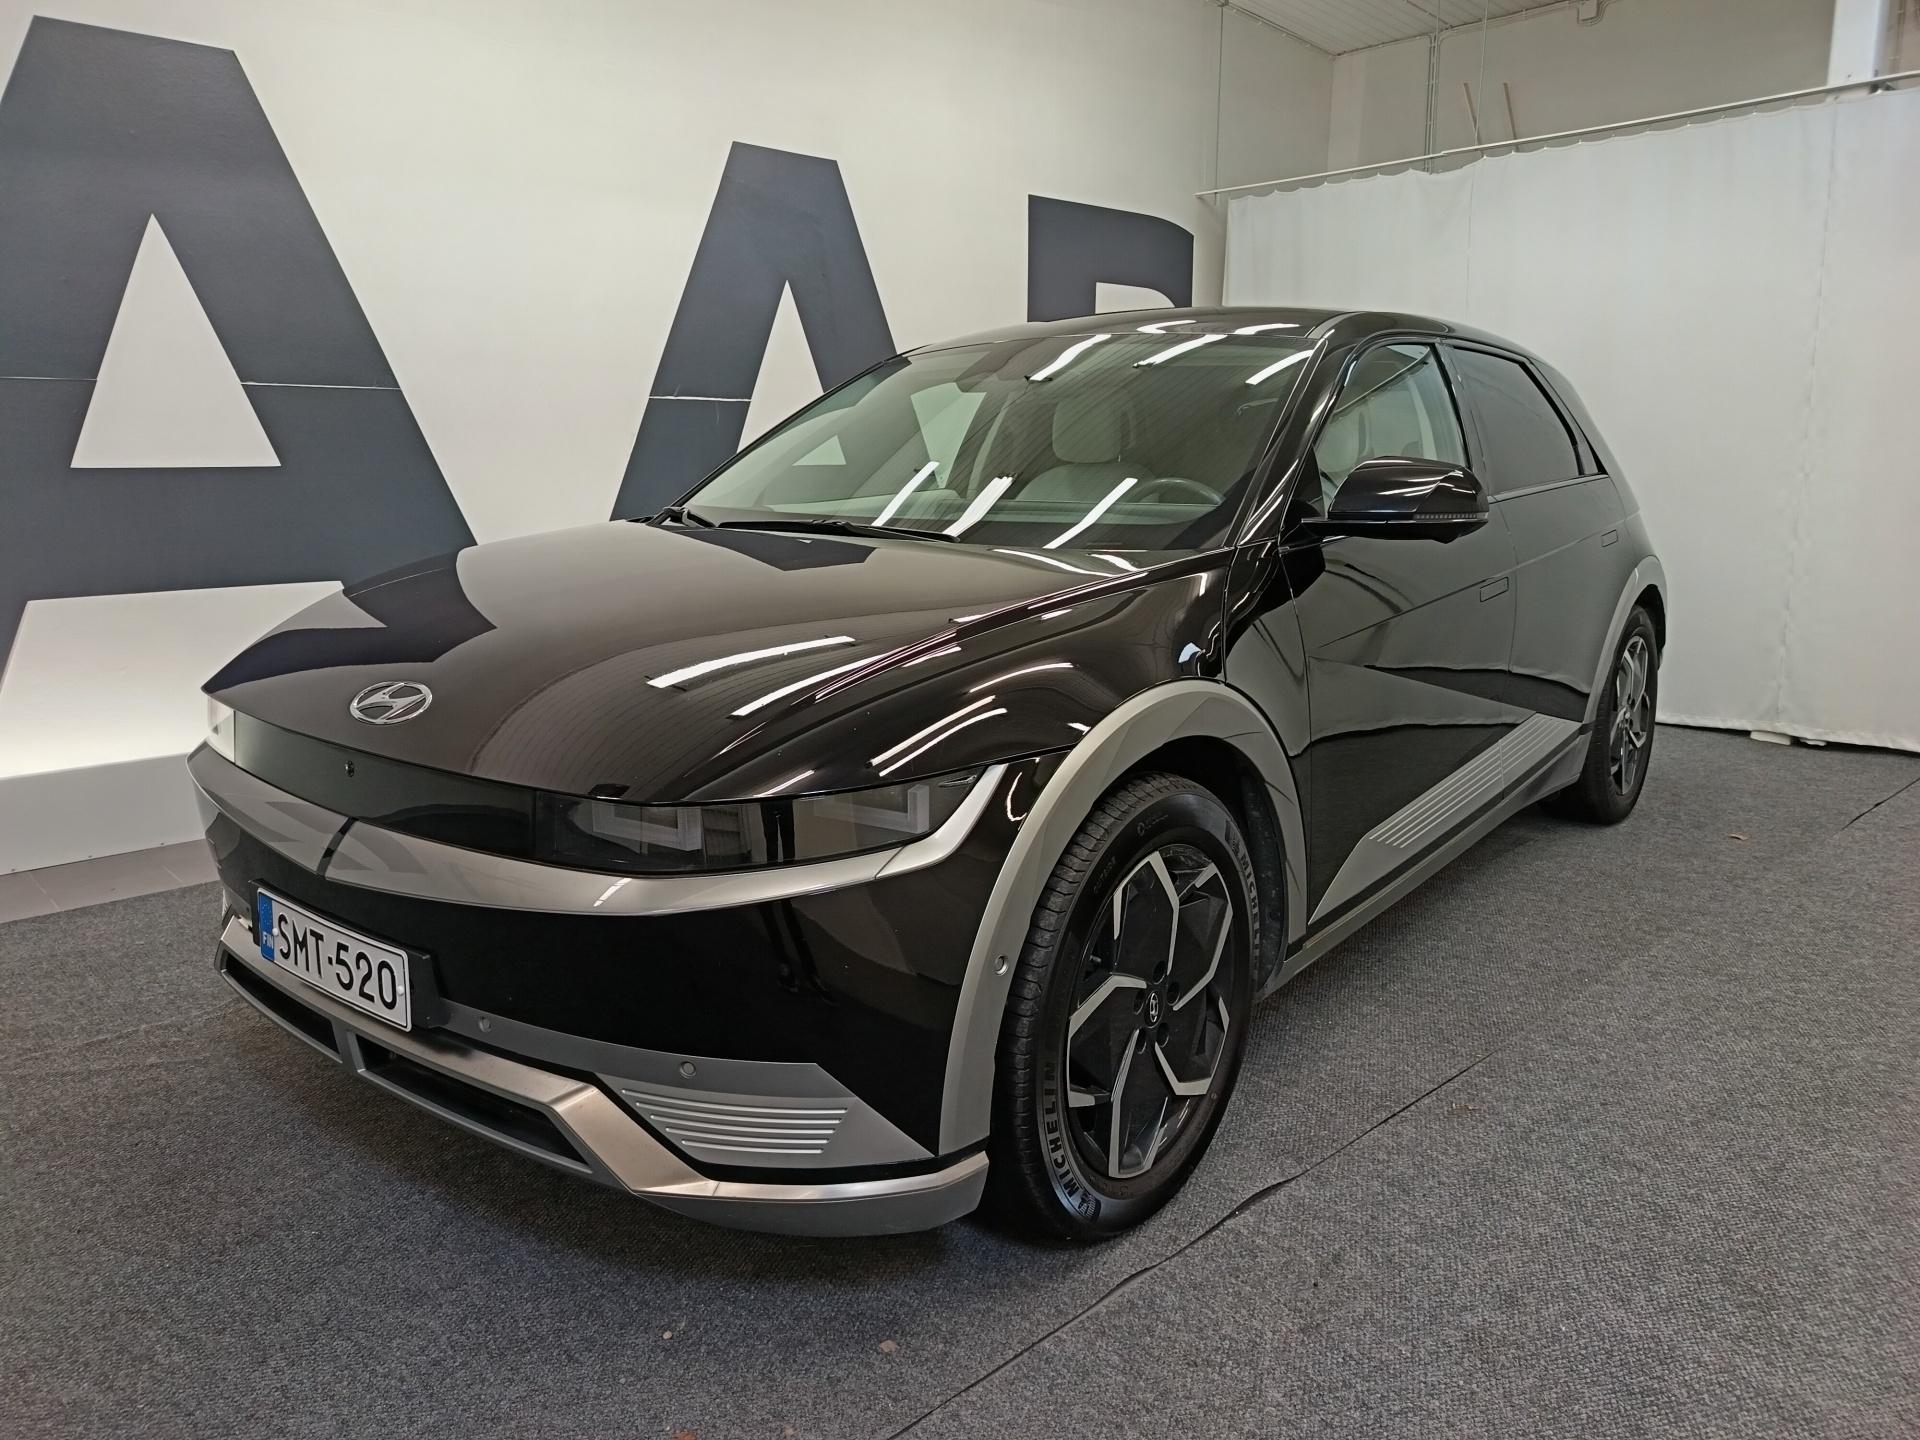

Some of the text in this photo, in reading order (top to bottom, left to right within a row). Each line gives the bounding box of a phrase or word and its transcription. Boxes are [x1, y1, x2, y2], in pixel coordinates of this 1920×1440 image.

[262, 931, 274, 950] FIN
[278, 913, 397, 1010] SMT-520
[1042, 1062, 1081, 1199] MICHELIN
